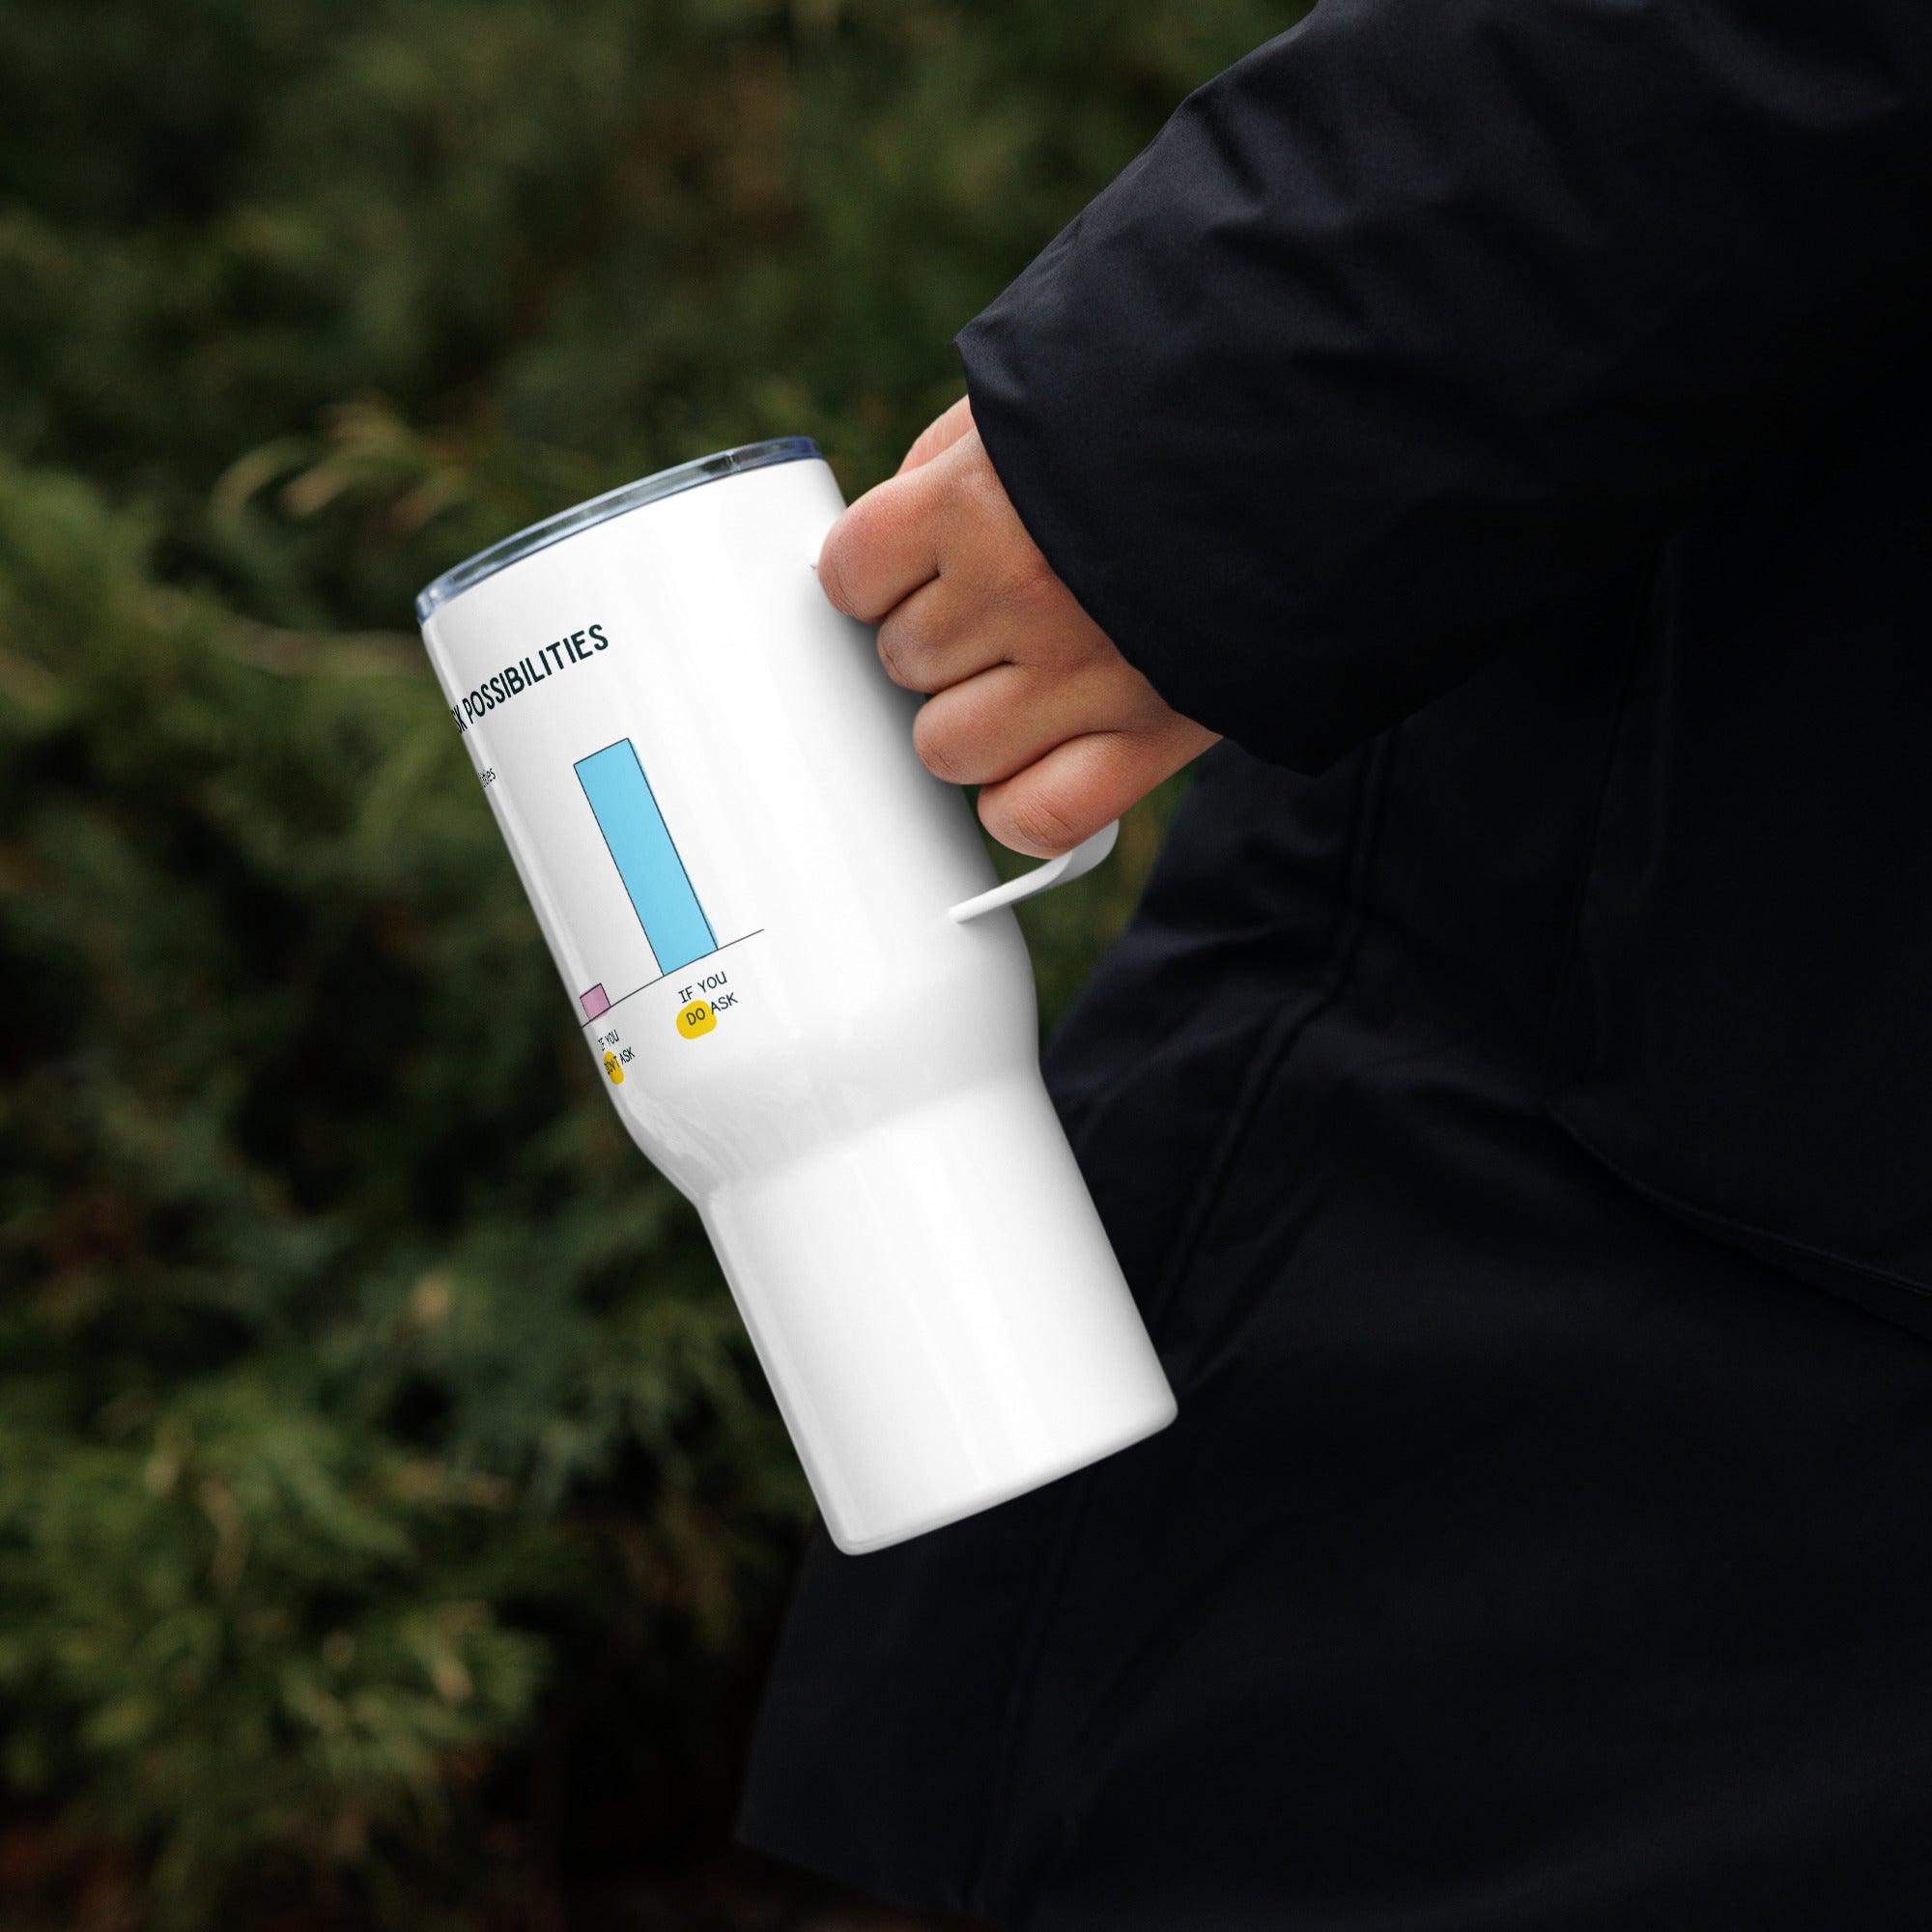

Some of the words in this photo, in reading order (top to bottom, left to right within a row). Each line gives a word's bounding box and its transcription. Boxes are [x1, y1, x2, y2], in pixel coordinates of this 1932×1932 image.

[462, 624, 609, 724] POSSIBILITIES
[678, 985, 693, 1004] IF
[697, 971, 727, 993] YOU
[686, 1008, 705, 1026] DO
[711, 992, 739, 1015] ASK
[605, 1029, 620, 1046] YOU
[619, 1046, 636, 1065] ASK
